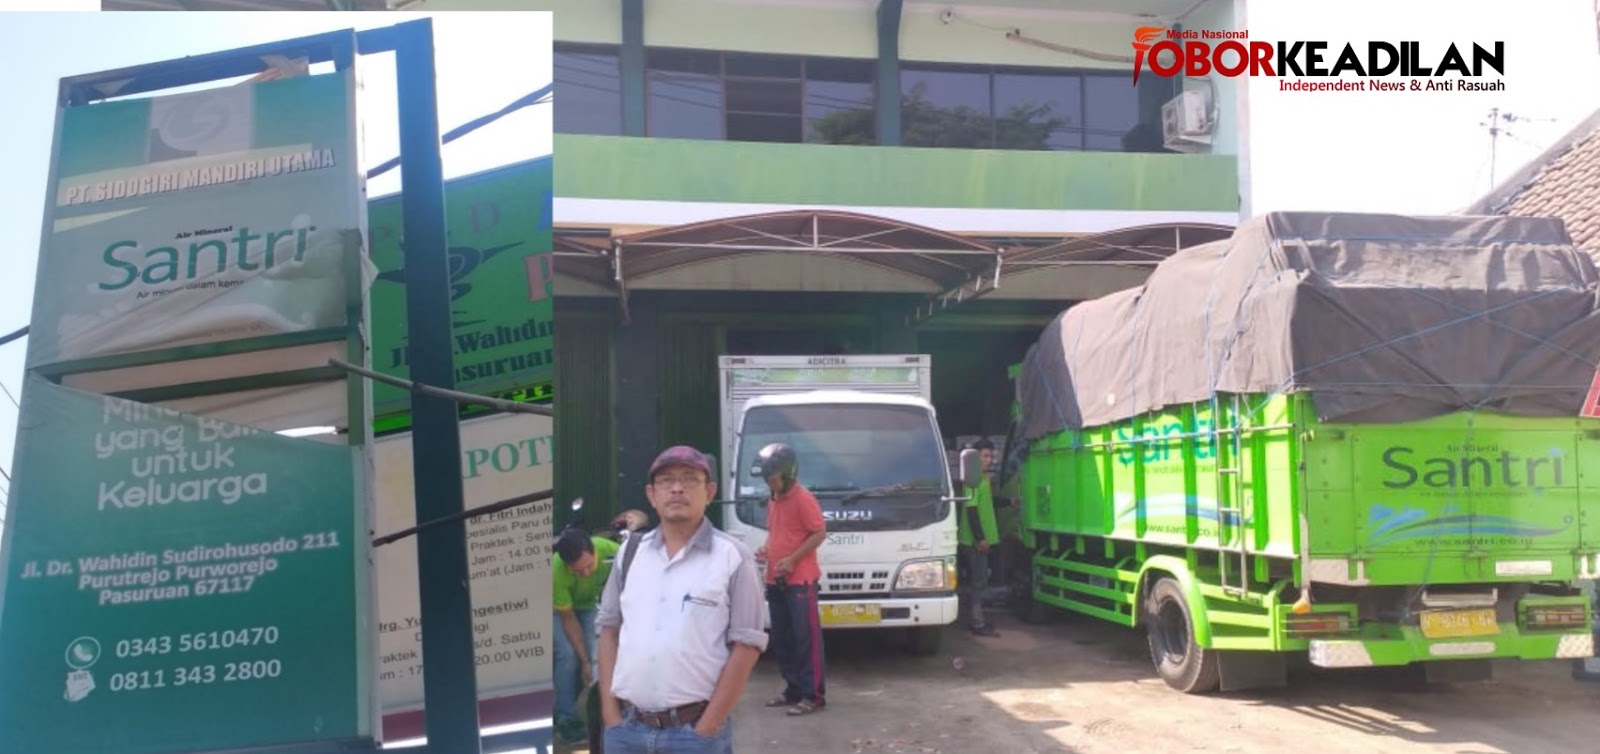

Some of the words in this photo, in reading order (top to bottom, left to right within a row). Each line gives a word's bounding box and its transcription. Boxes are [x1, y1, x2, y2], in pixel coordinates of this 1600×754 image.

[184, 160, 267, 189] MANDIRI
[270, 148, 337, 177] UTAMA
[98, 215, 311, 291] Santri
[95, 424, 184, 458] yang
[131, 442, 235, 478] untuk
[1382, 446, 1563, 489] Santri
[97, 472, 268, 511] Keluarga
[822, 510, 873, 521] SUZU
[45, 560, 73, 577] Dr.
[77, 551, 157, 573] Wahidin
[162, 536, 298, 566] Sudirohusodo
[302, 531, 340, 550] 211
[470, 538, 515, 551] Praktek
[826, 532, 865, 545] Santri
[77, 568, 170, 591] Purutrejo
[175, 557, 279, 581] Purworejo
[471, 555, 497, 566] Jam
[98, 585, 190, 606] Pasuruan
[194, 575, 256, 597] 67117
[115, 636, 172, 658] 0343
[178, 626, 280, 652] 5610470
[501, 631, 541, 645] Sabtu
[514, 646, 545, 660] WIB
[109, 672, 166, 692] 0811
[173, 667, 217, 685] 343
[224, 659, 282, 681] 2800
